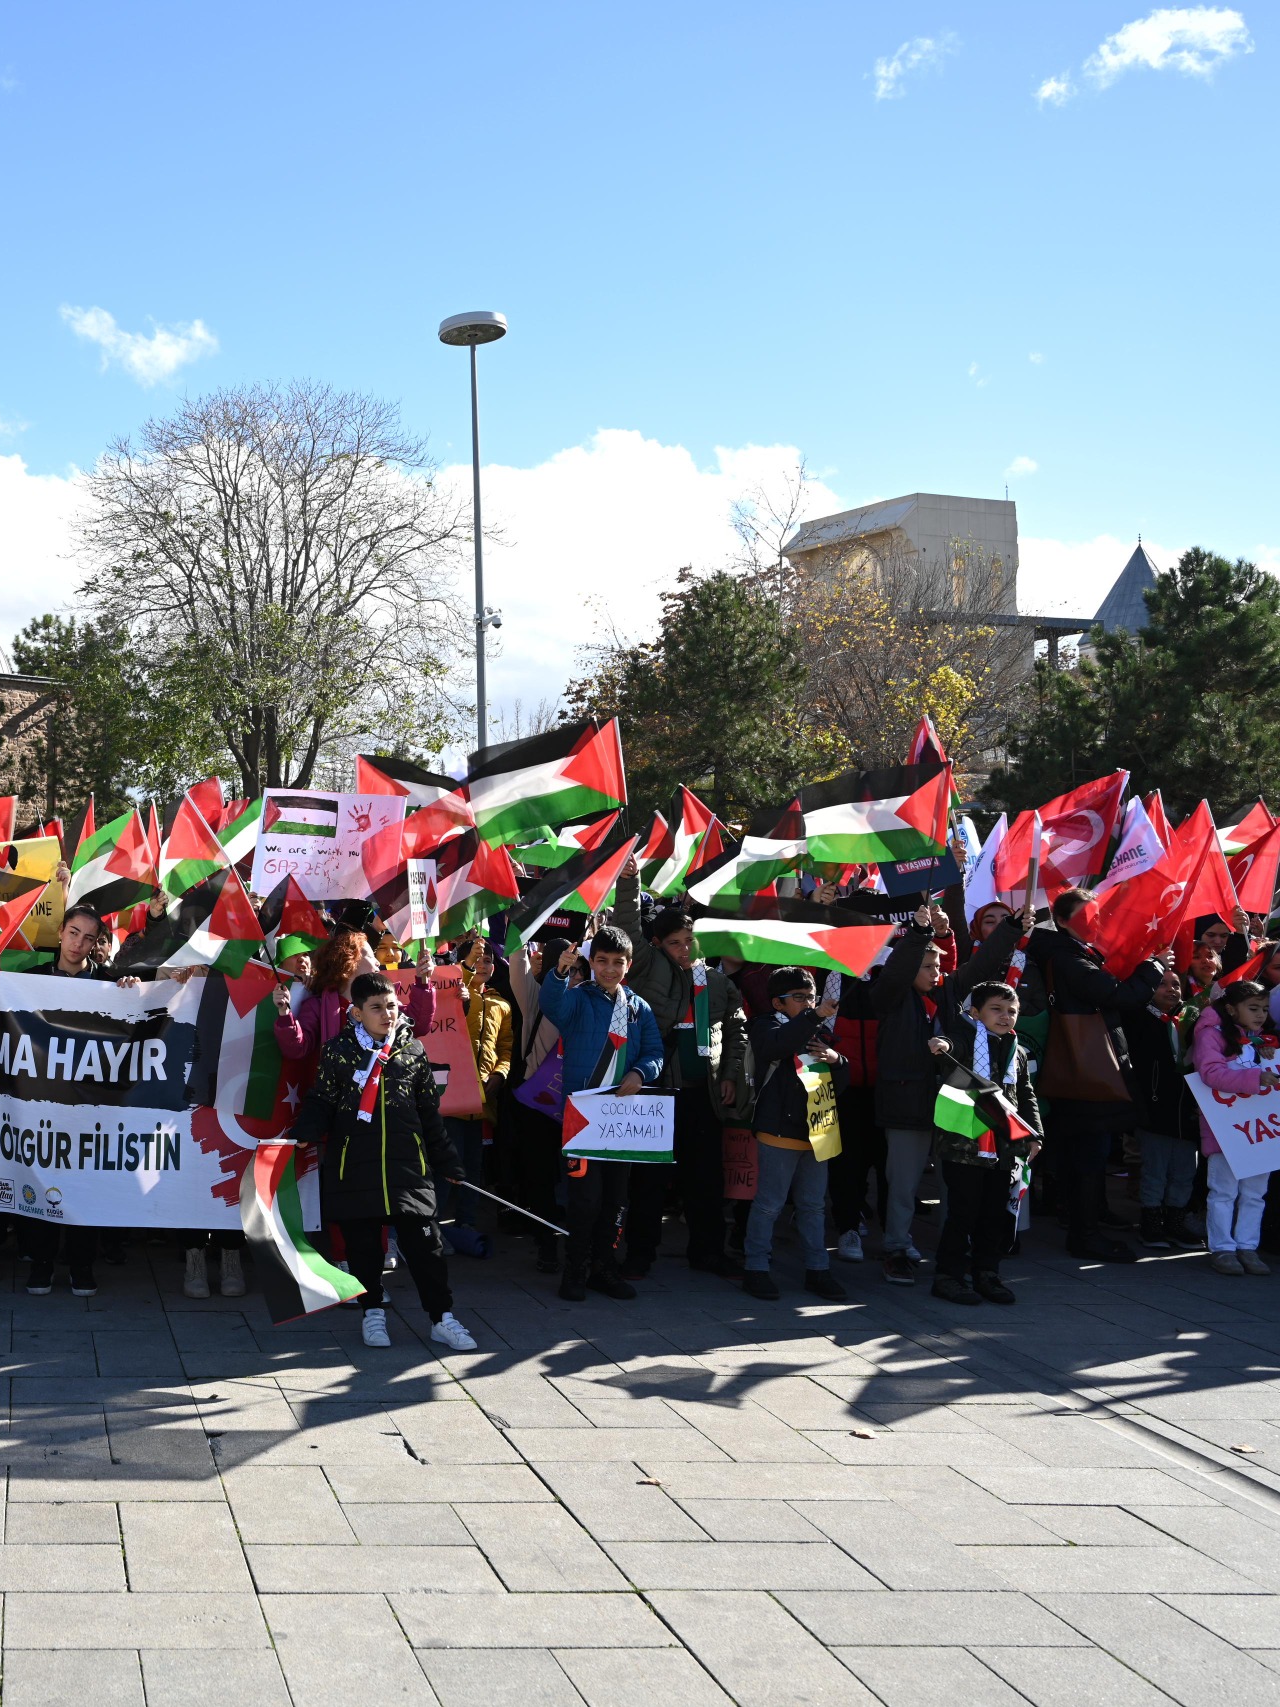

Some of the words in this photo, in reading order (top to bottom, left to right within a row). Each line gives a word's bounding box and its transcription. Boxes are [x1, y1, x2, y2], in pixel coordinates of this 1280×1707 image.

[288, 847, 307, 855] are
[348, 850, 360, 858] you
[46, 1036, 168, 1083] HAYIR
[813, 1081, 835, 1106] SAVE
[0, 1112, 72, 1171] ÖZGÜR
[78, 1121, 181, 1172] FİLİSTİN
